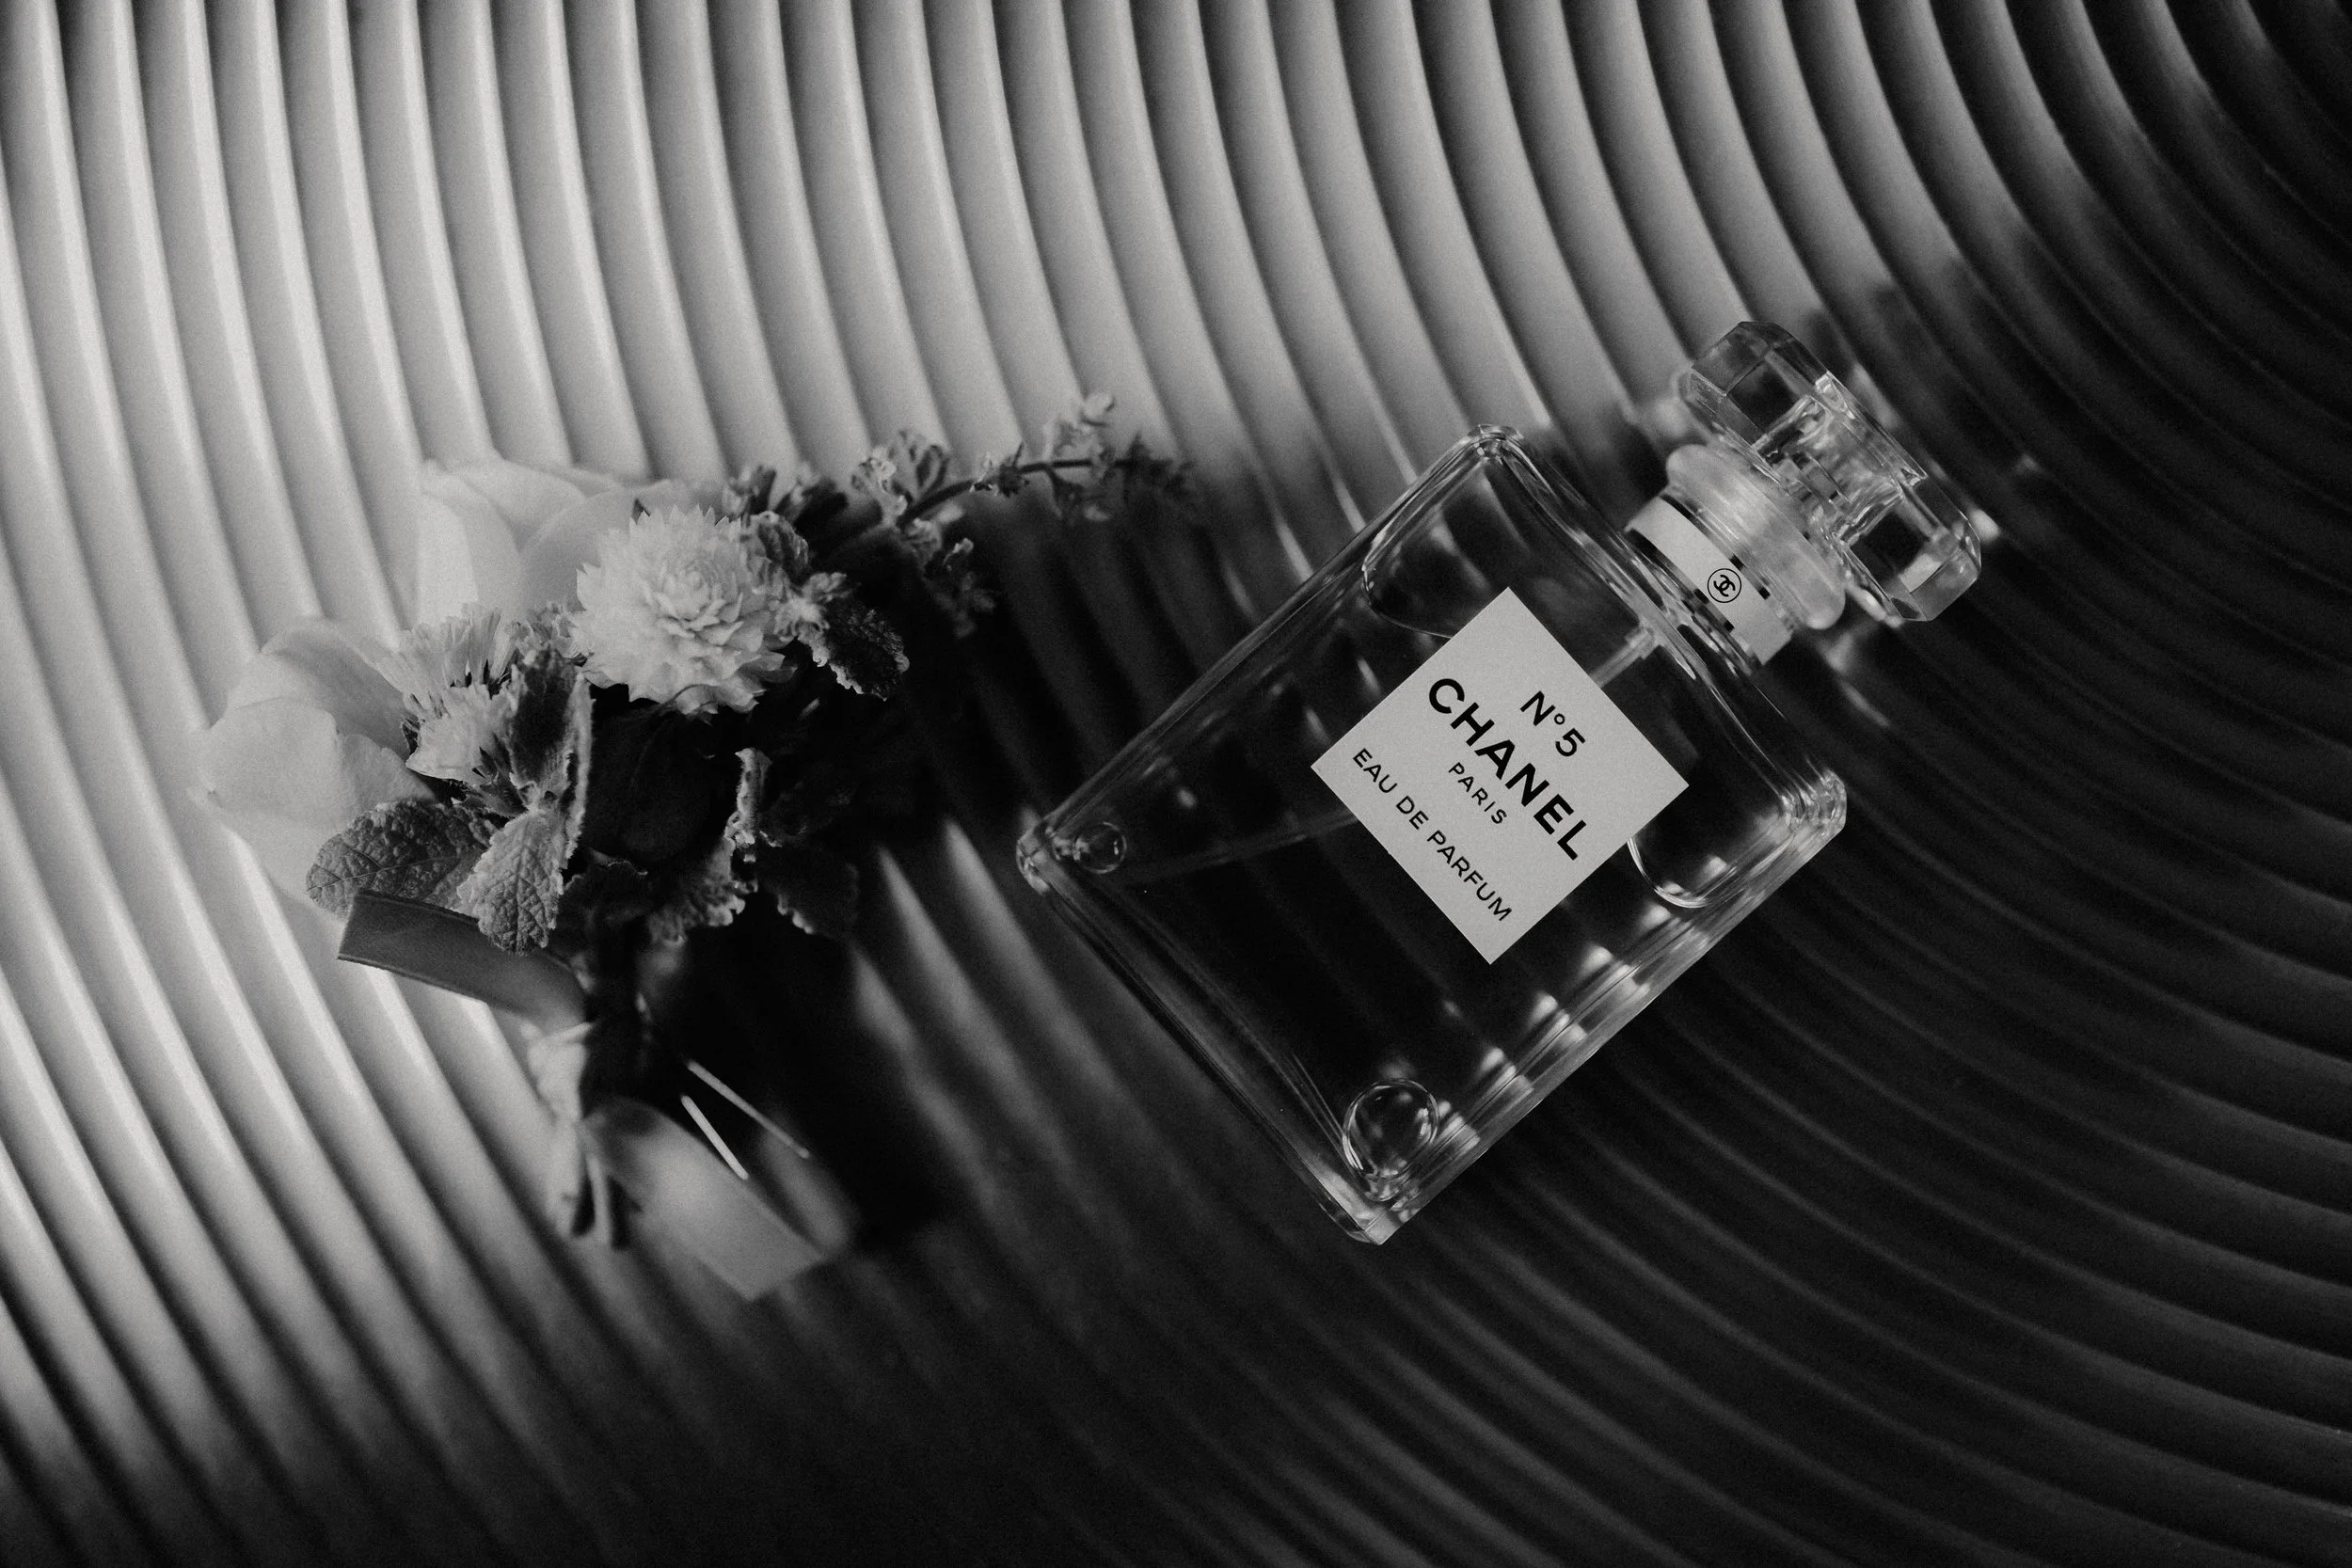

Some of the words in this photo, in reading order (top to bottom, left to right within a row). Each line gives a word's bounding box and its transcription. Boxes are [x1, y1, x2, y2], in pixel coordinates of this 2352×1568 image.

[1352, 747, 1398, 794] EAU
[1395, 795, 1430, 831] DE
[1426, 829, 1513, 922] PARFUM
[1428, 677, 1587, 862] CHANEL
[1448, 761, 1508, 825] PARIS
